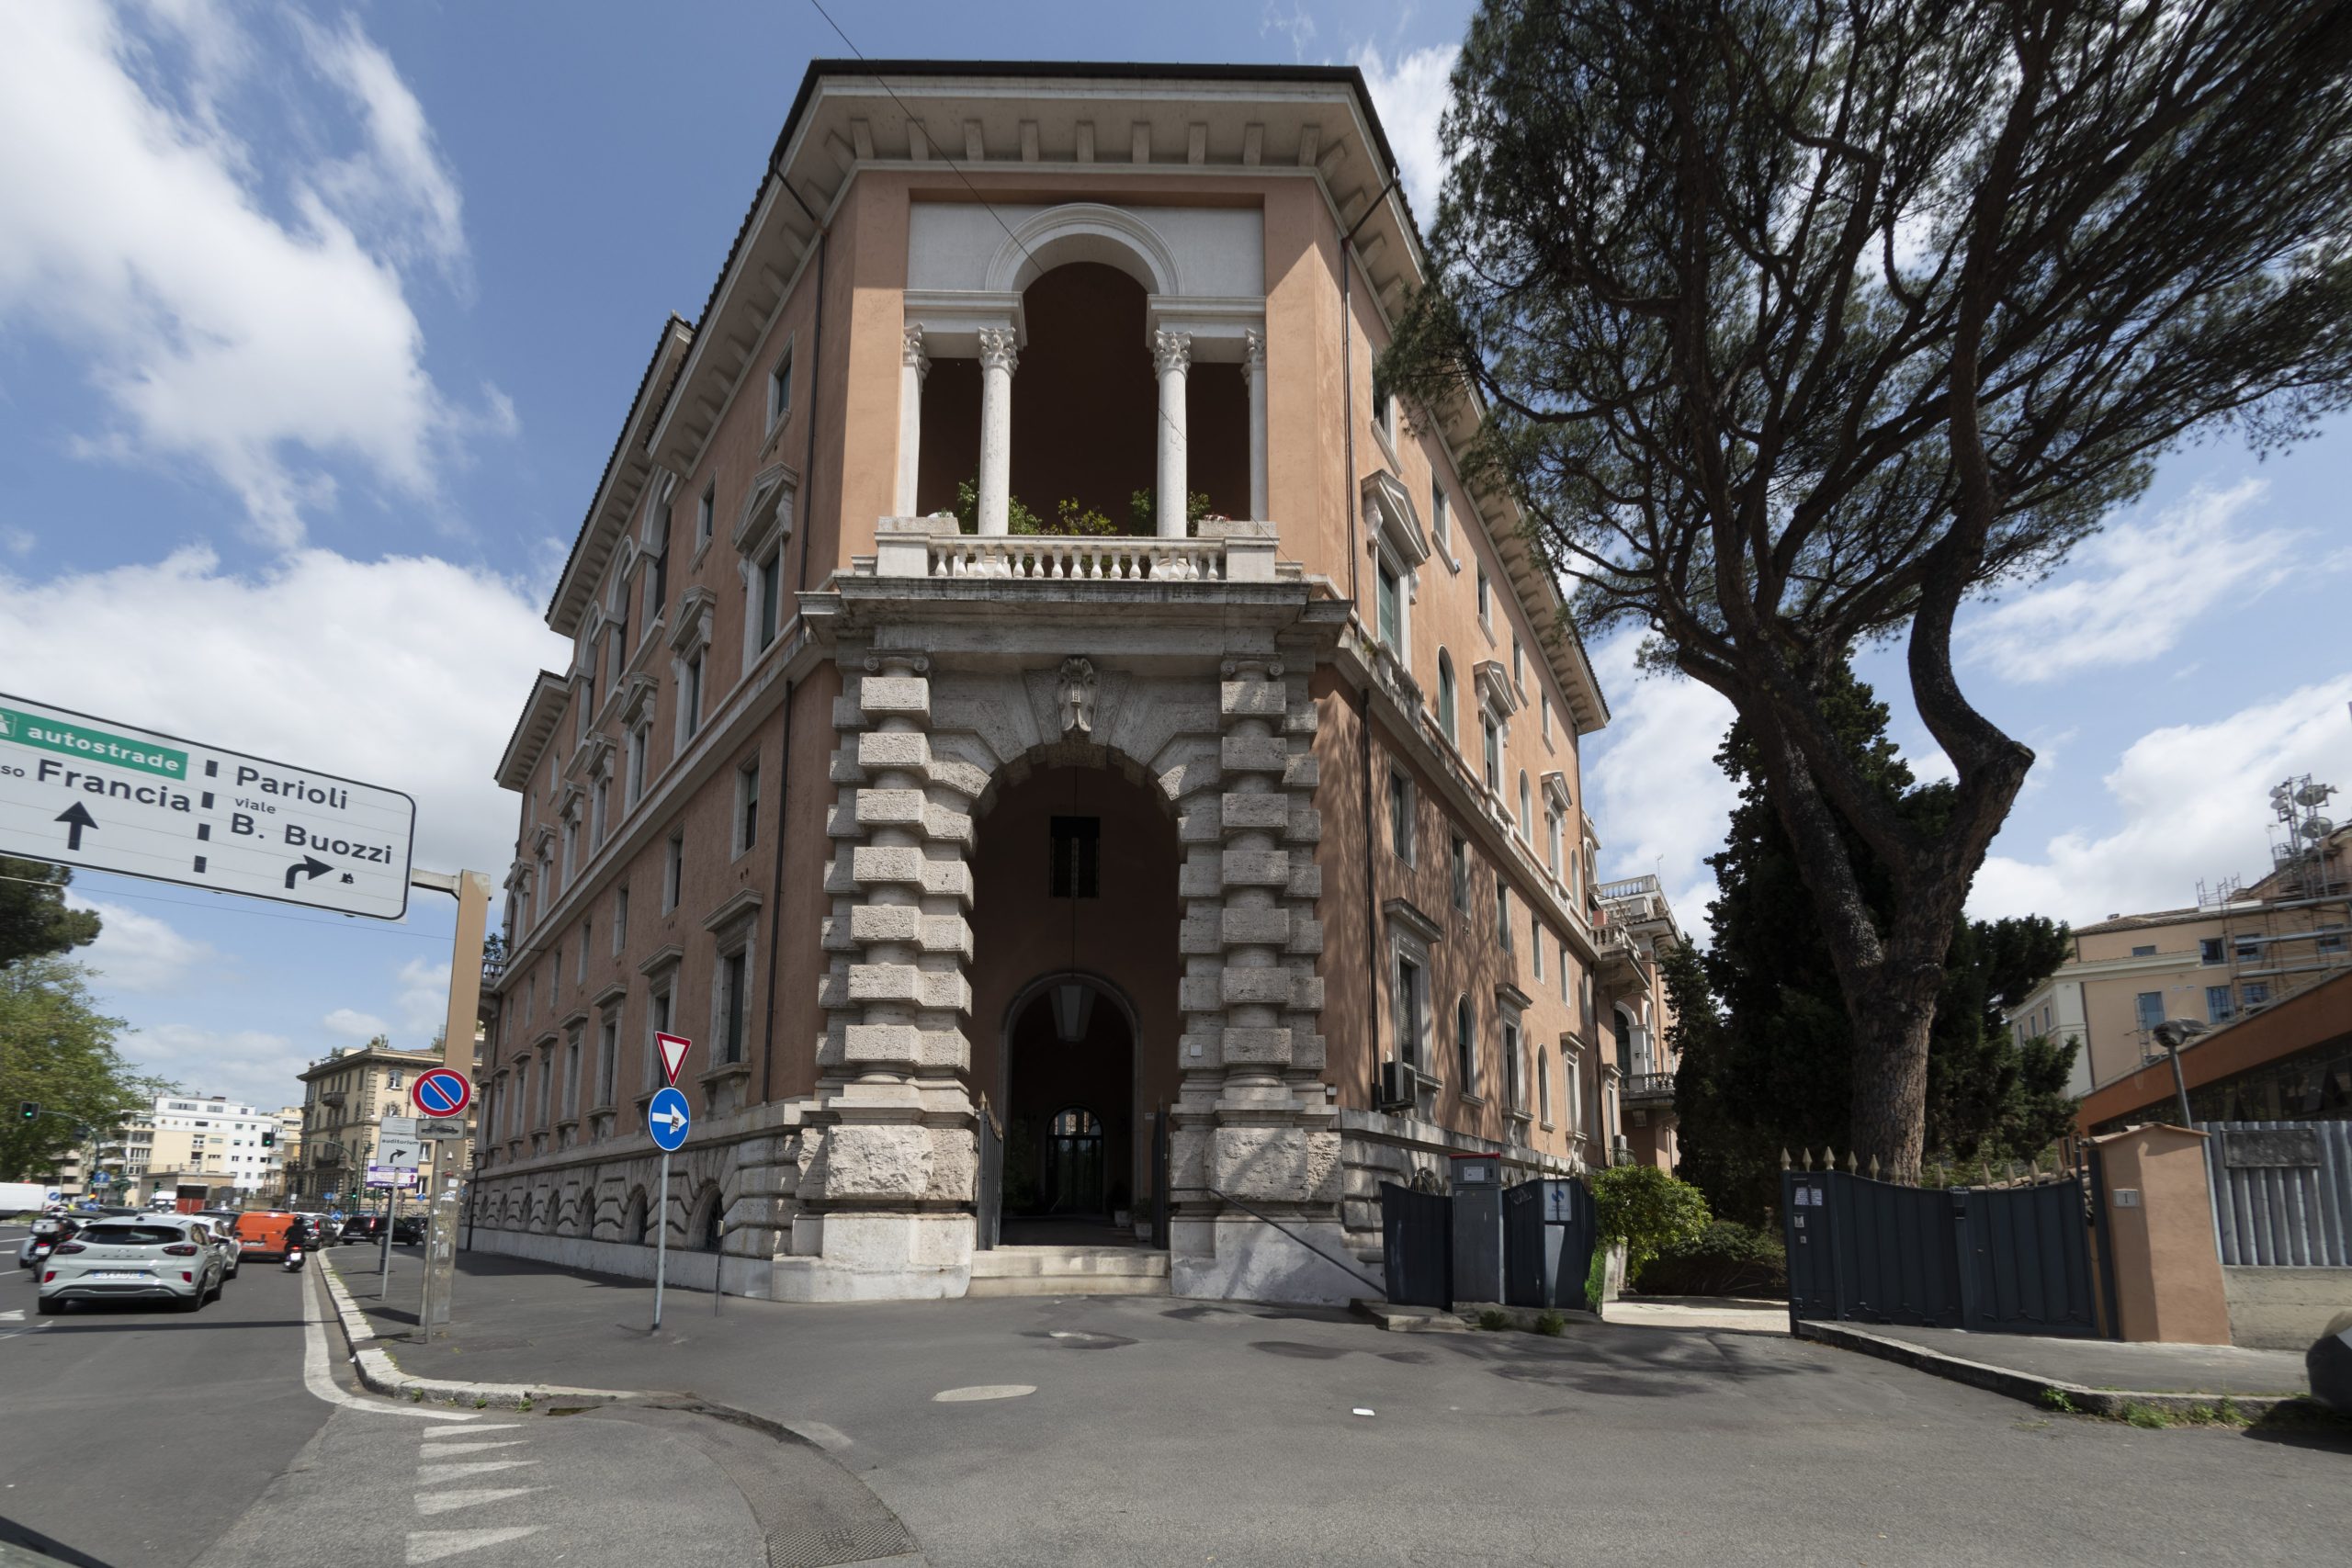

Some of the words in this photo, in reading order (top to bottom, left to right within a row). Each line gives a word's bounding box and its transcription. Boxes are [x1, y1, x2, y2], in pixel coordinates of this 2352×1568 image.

[28, 727, 179, 772] autostrade
[38, 759, 191, 813] Francia
[234, 797, 277, 815] viale
[236, 765, 347, 810] Parioli
[231, 812, 265, 840] B.
[284, 823, 392, 864] Buozzi
